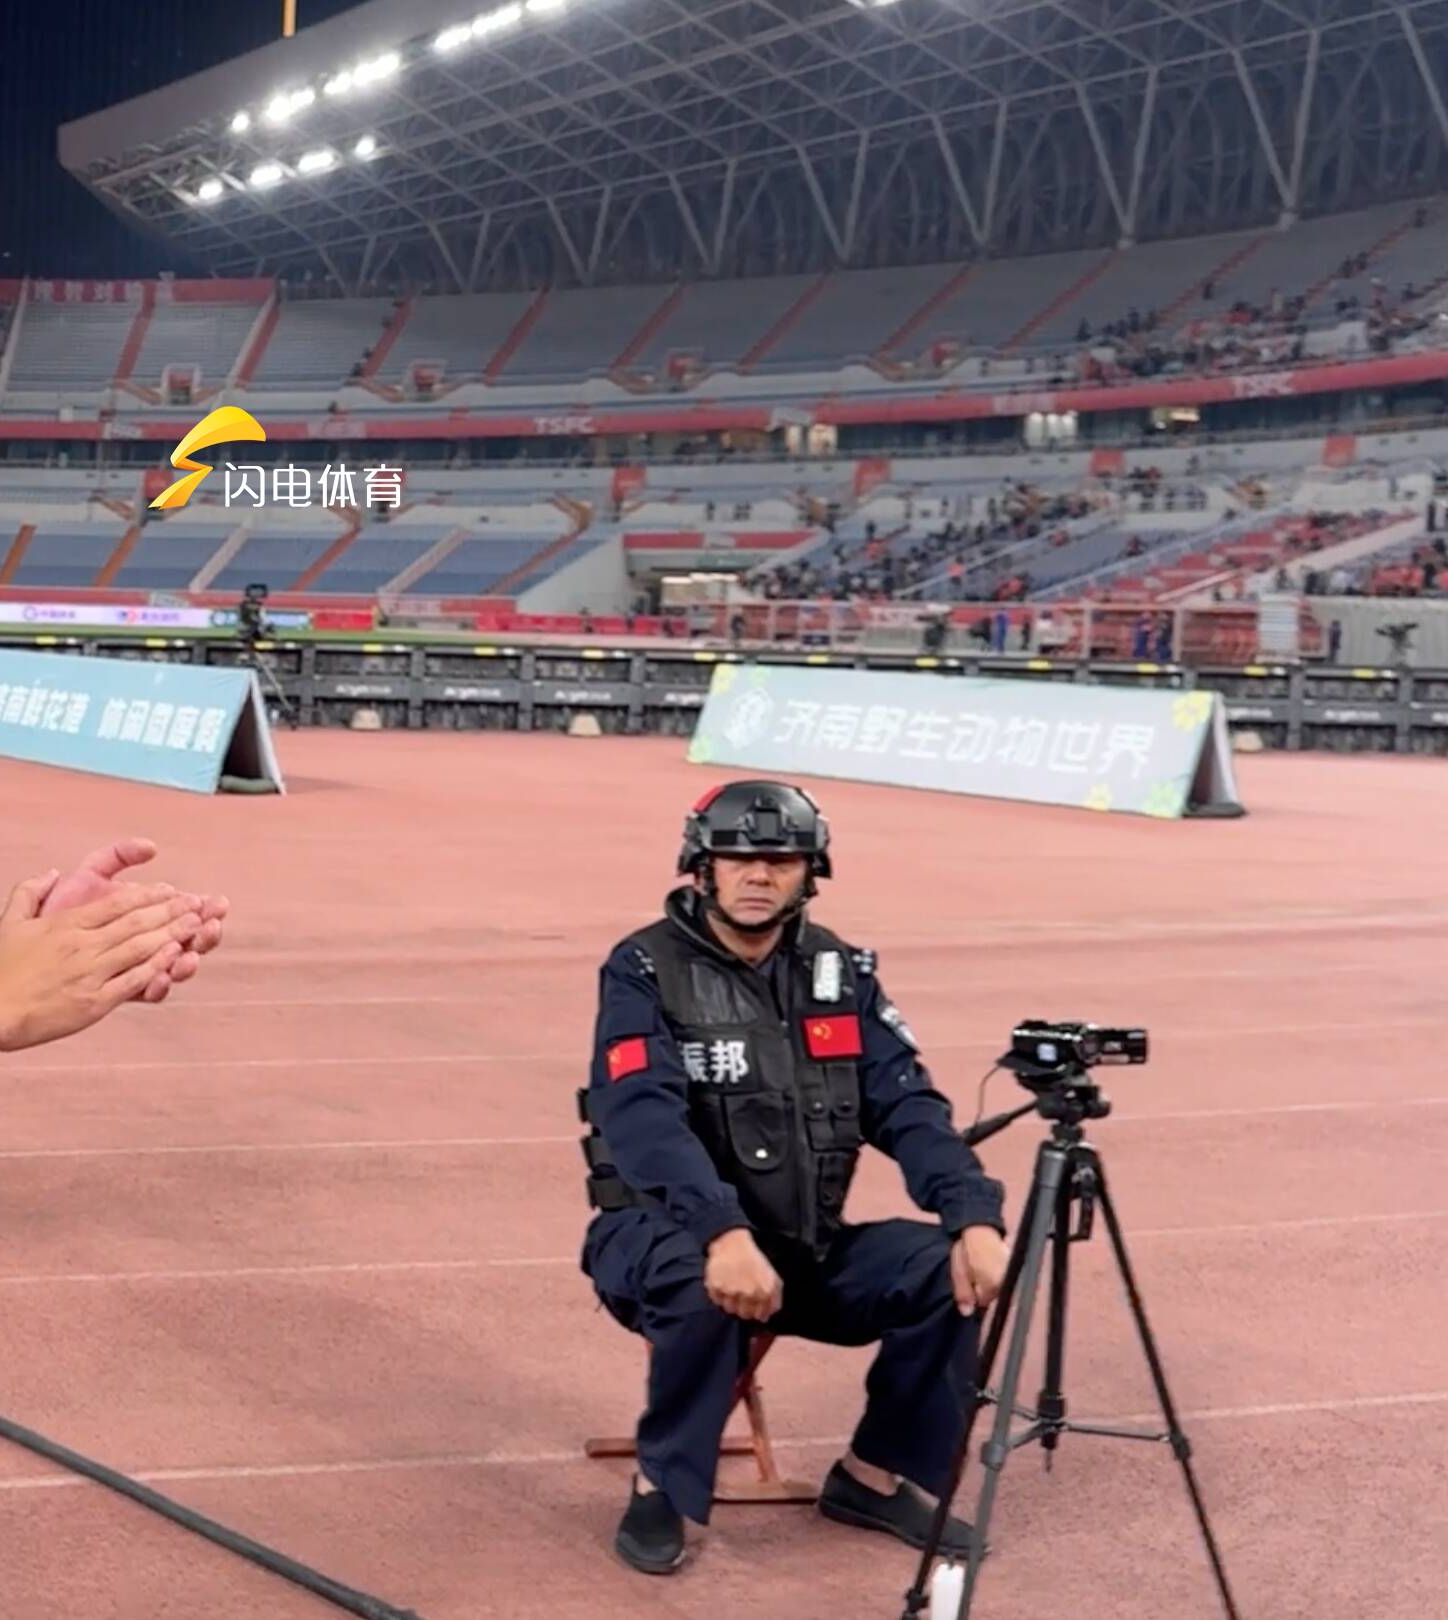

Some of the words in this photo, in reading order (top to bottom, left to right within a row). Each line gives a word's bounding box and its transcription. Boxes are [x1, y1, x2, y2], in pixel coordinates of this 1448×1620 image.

[773, 700, 1153, 779] 济南野生动物世界
